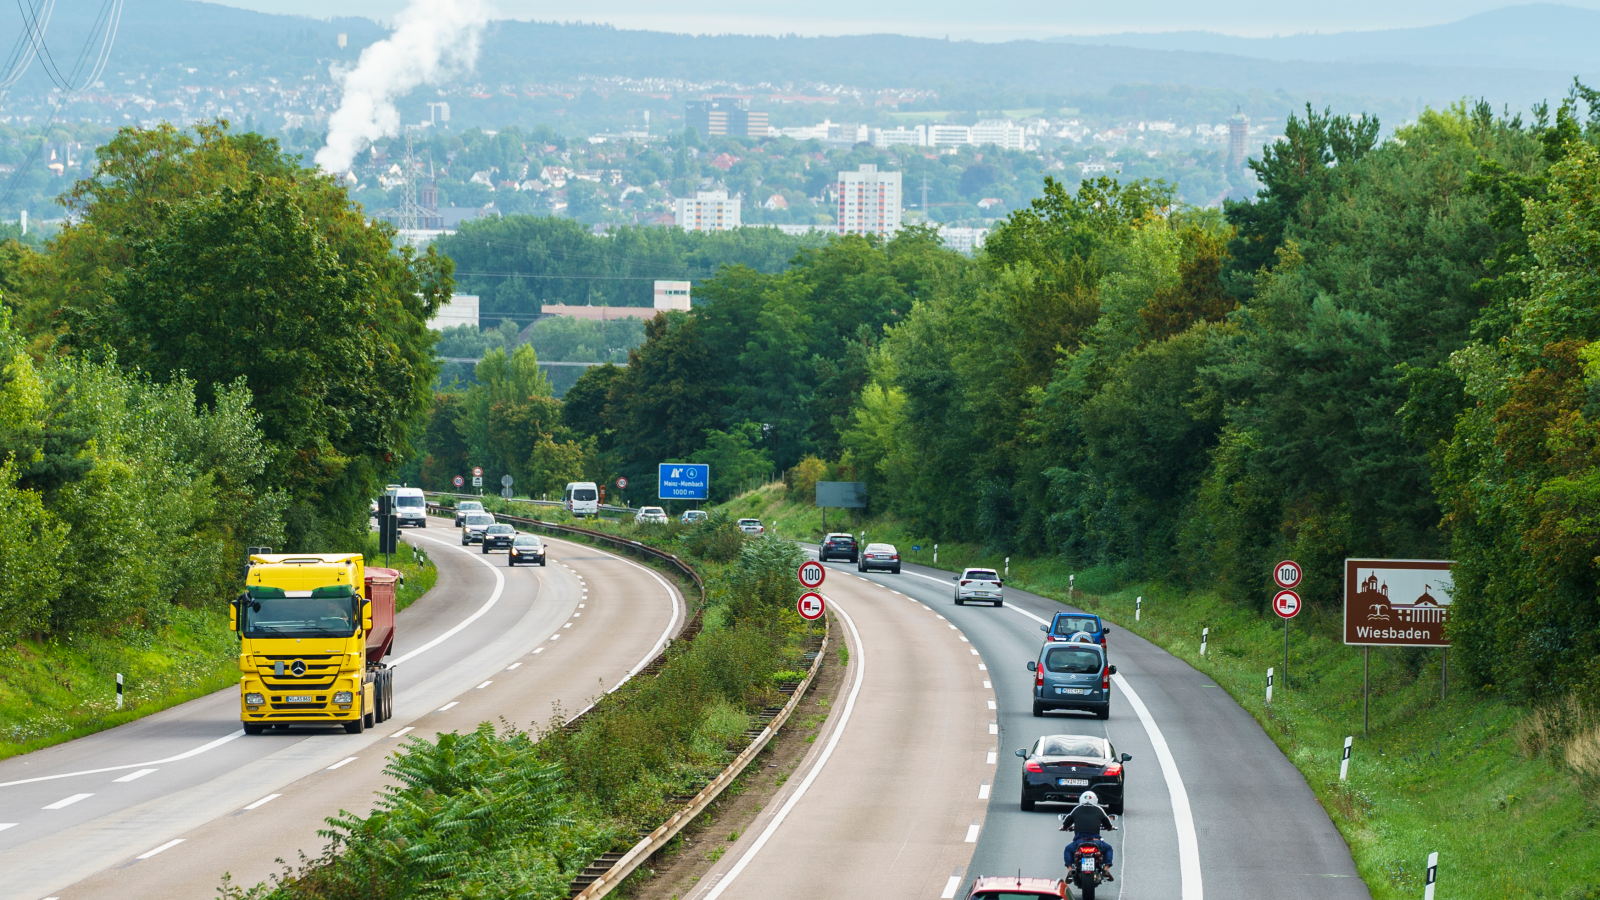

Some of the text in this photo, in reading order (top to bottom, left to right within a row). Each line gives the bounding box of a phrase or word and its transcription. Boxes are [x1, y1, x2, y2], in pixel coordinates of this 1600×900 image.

[803, 568, 820, 581] 100
[1280, 568, 1297, 581] 100
[1356, 626, 1430, 640] Wiesbaden
